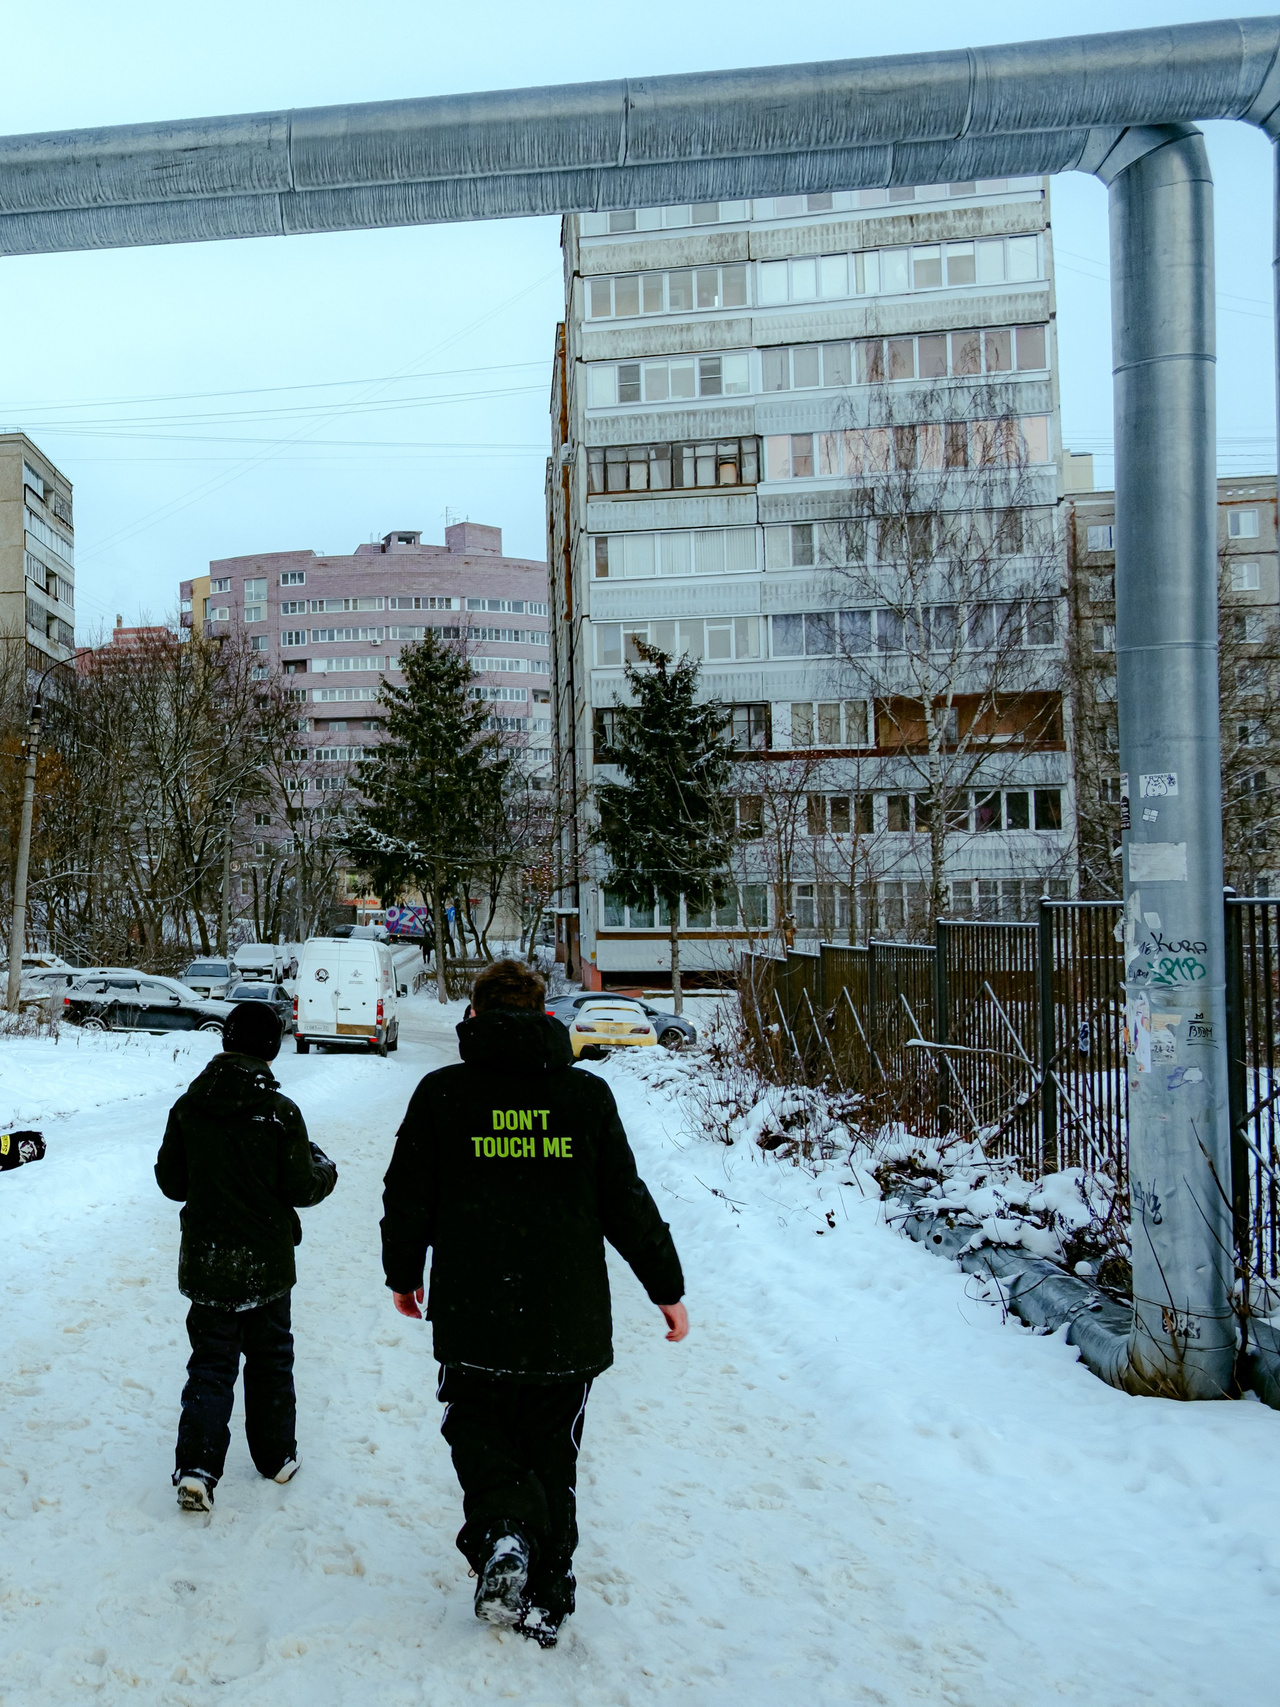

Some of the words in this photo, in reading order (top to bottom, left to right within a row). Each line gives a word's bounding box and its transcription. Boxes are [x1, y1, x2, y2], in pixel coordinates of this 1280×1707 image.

[492, 1109, 550, 1131] DON'T
[471, 1136, 536, 1158] TOUCH
[542, 1137, 573, 1158] ME
